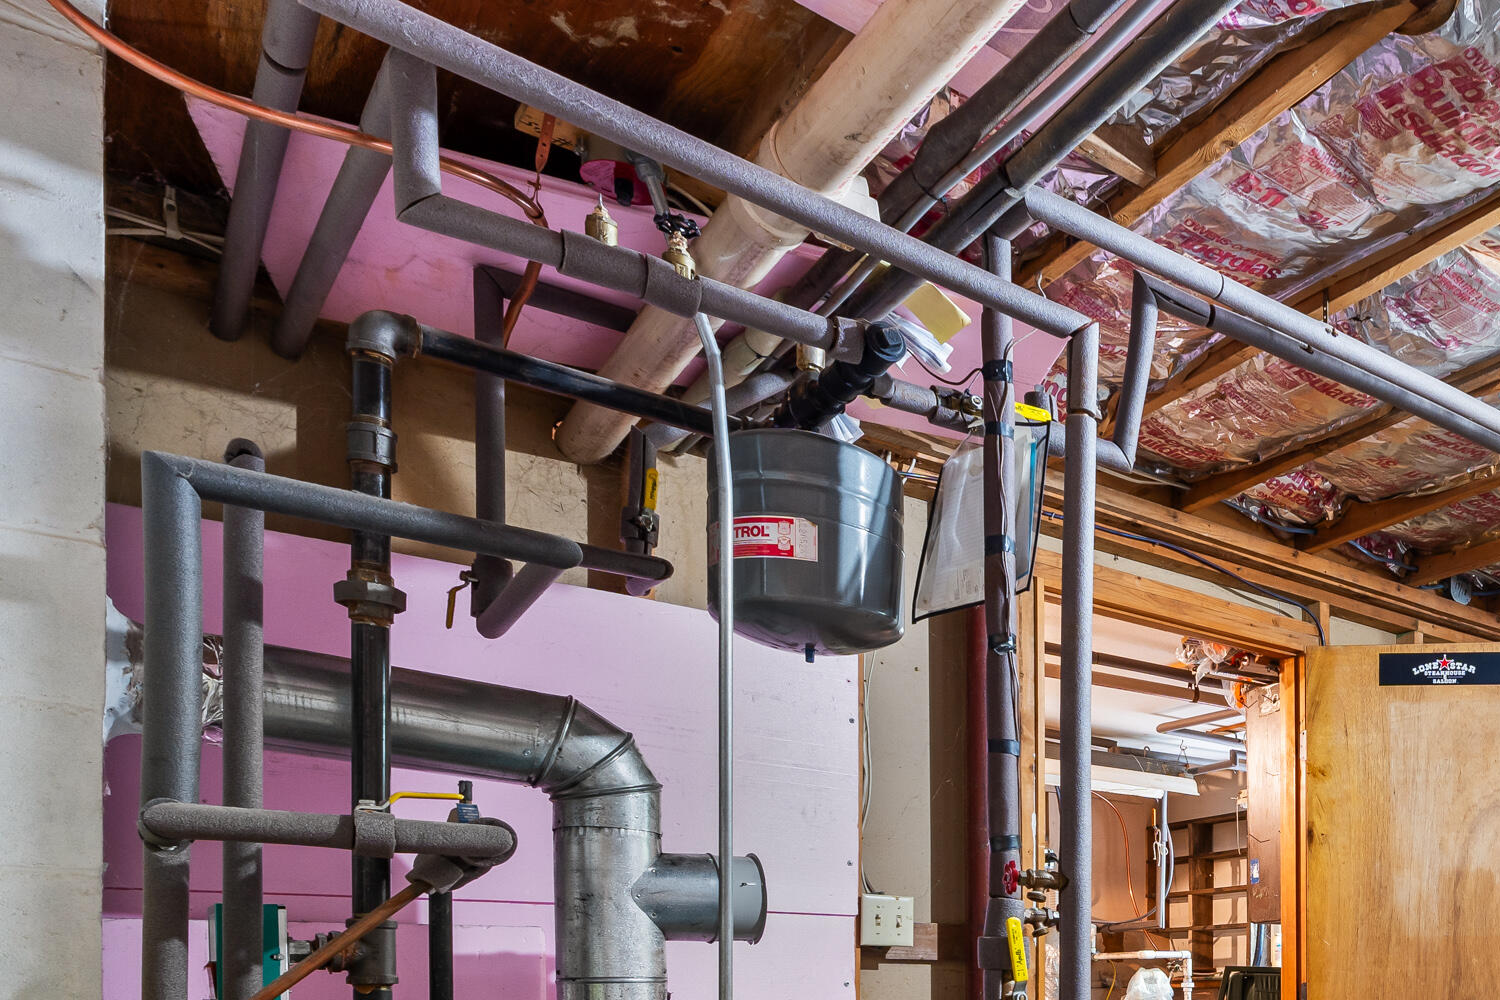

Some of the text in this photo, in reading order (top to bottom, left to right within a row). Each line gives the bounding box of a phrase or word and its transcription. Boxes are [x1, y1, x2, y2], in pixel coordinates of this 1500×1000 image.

[734, 525, 770, 539] TROL
[1412, 661, 1476, 675] LONE STAR
